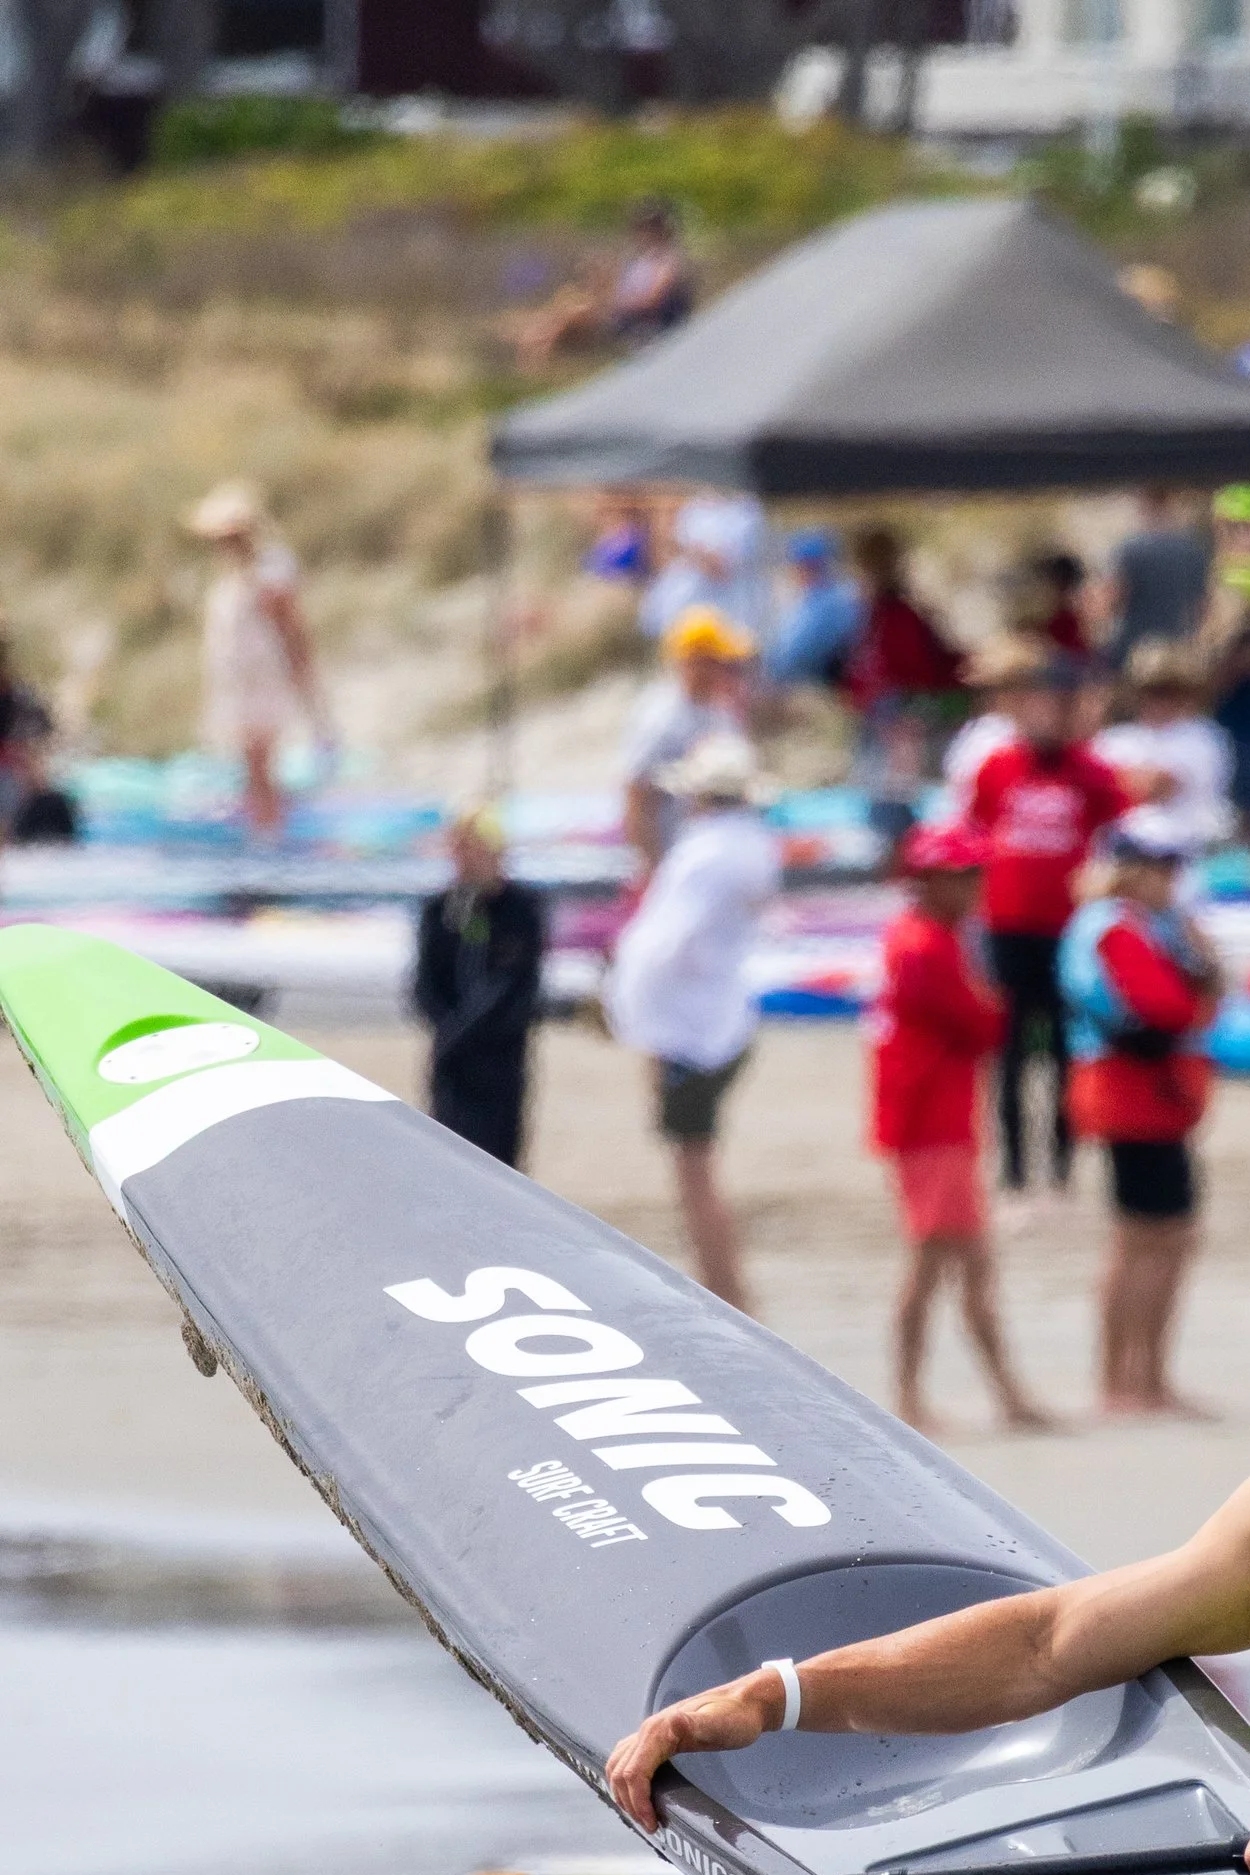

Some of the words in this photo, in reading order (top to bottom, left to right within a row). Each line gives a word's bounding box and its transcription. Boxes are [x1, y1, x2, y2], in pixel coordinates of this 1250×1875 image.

[383, 1266, 832, 1530] SONIC
[507, 1459, 595, 1502] SURF
[552, 1498, 649, 1548] CRAFT
